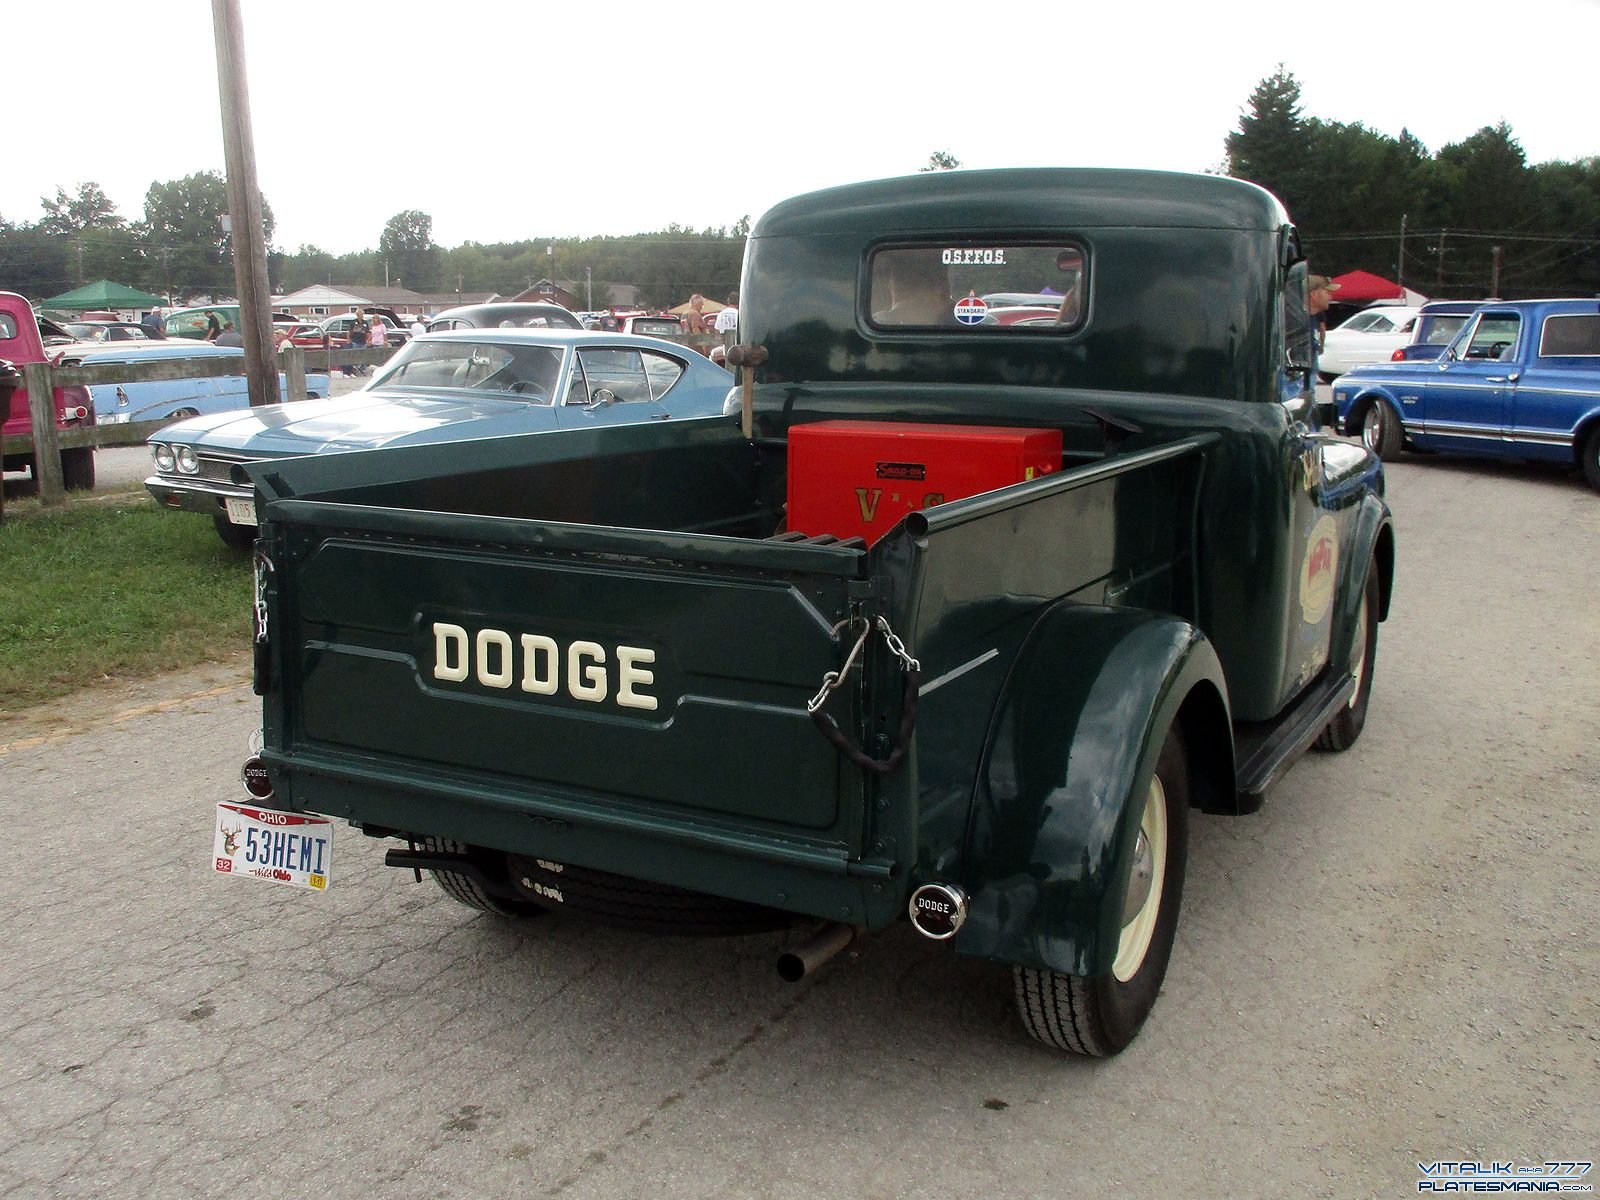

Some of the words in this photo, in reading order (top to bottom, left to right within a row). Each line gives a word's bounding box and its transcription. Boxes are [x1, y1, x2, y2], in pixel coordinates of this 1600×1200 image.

[432, 621, 659, 711] DODGE
[258, 811, 288, 825] OHIO
[245, 826, 327, 875] 53HEMI
[216, 859, 231, 870] 32
[249, 867, 273, 878] Wild
[272, 868, 292, 882] Ohio
[918, 897, 950, 914] DODGE
